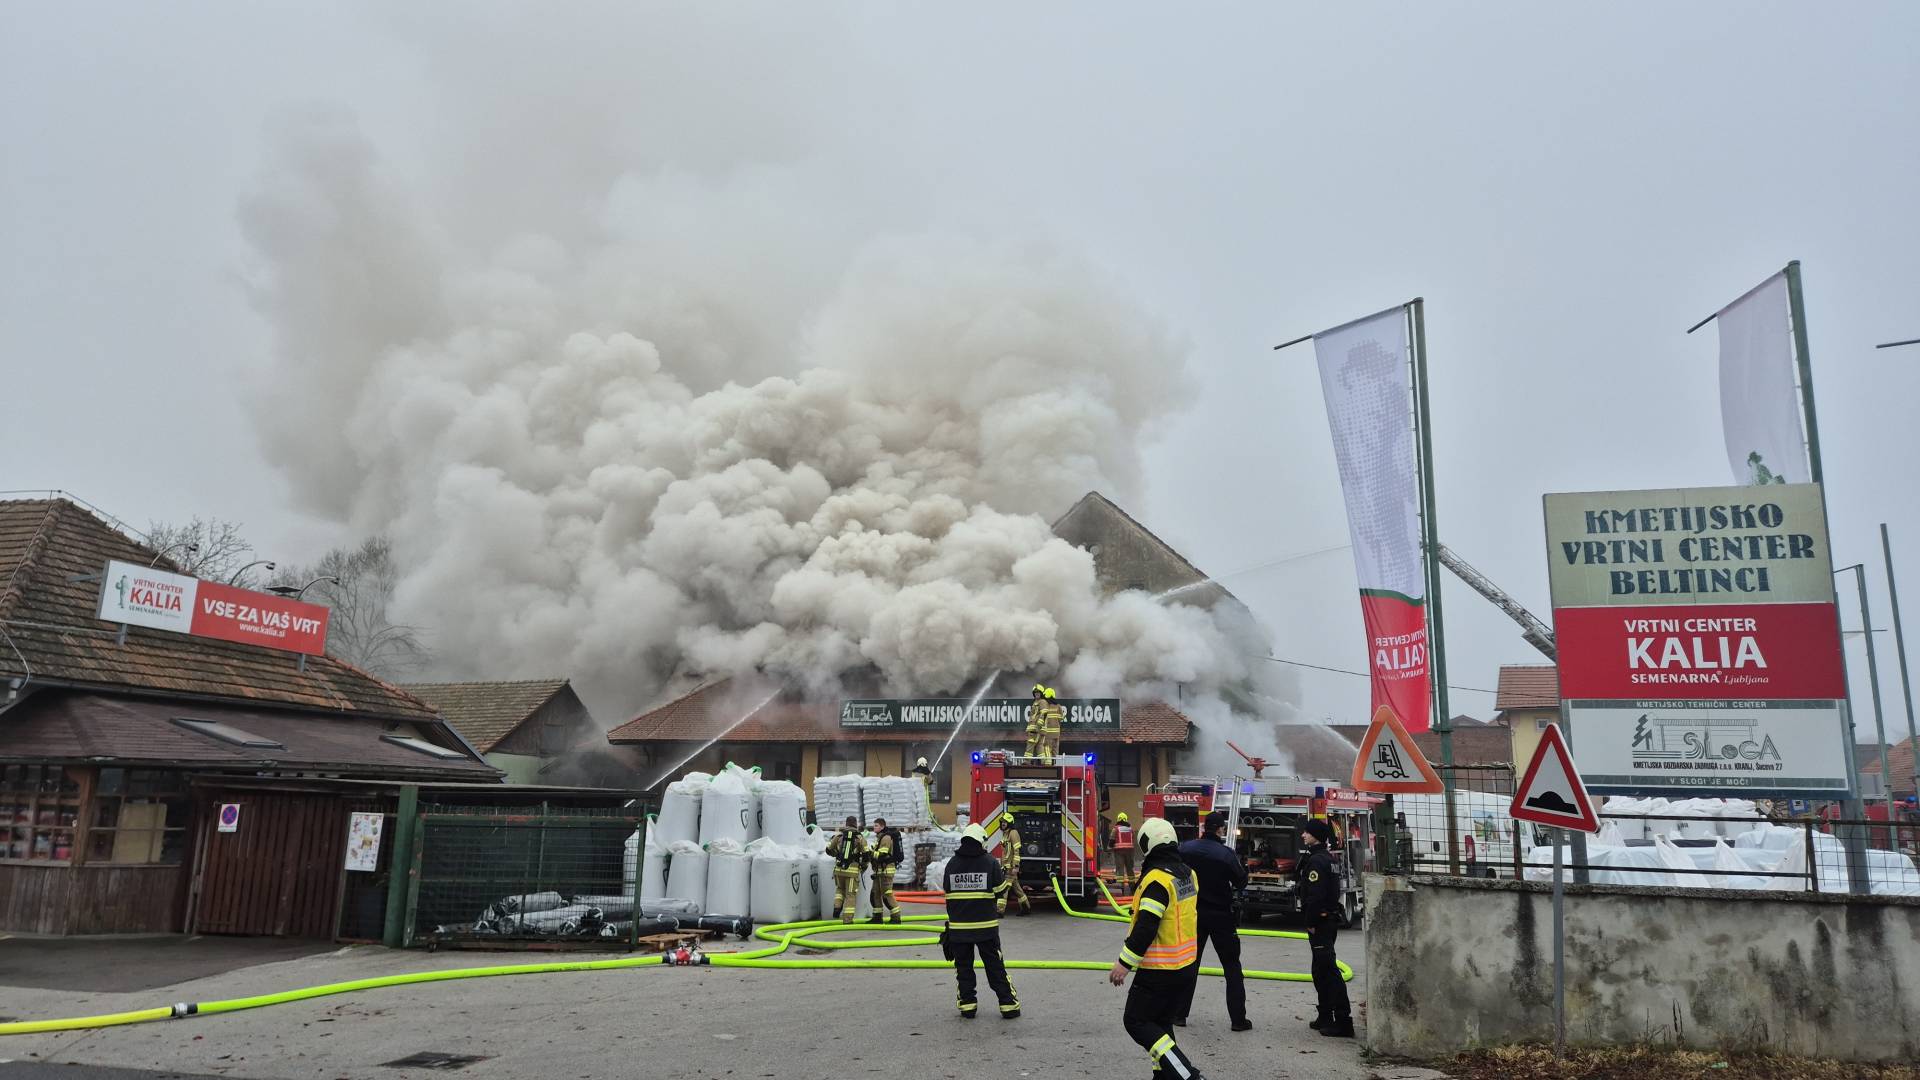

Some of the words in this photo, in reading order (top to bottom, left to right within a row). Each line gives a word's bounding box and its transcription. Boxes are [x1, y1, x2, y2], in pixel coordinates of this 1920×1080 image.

[1585, 503, 1784, 534] KMETIJSKO
[1561, 539, 1664, 565] VRTNI
[1678, 534, 1815, 562] CENTER
[133, 578, 155, 589] VRTNI
[156, 583, 183, 594] CENTER
[1610, 567, 1771, 595] BELTINCI
[130, 587, 181, 612] KALIA
[203, 598, 235, 619] VSE
[236, 605, 259, 623] ZA
[261, 610, 289, 629] VAŠ
[292, 616, 321, 634] VRT
[239, 622, 285, 638] www.kalia.si
[1624, 619, 1680, 633] VRTNI
[1684, 618, 1757, 632] CENTER
[1627, 636, 1768, 669] KALIA
[1631, 673, 1721, 684] SEMENARNA
[1724, 674, 1769, 685] Ljubljana
[1687, 700, 1728, 708] TEHNIČNI
[901, 706, 962, 723] KMETIJSKO
[1070, 706, 1113, 723] SLOGA
[1681, 777, 1707, 785] SLOGI
[1711, 777, 1721, 785] JE
[954, 873, 983, 884] GASILEC
